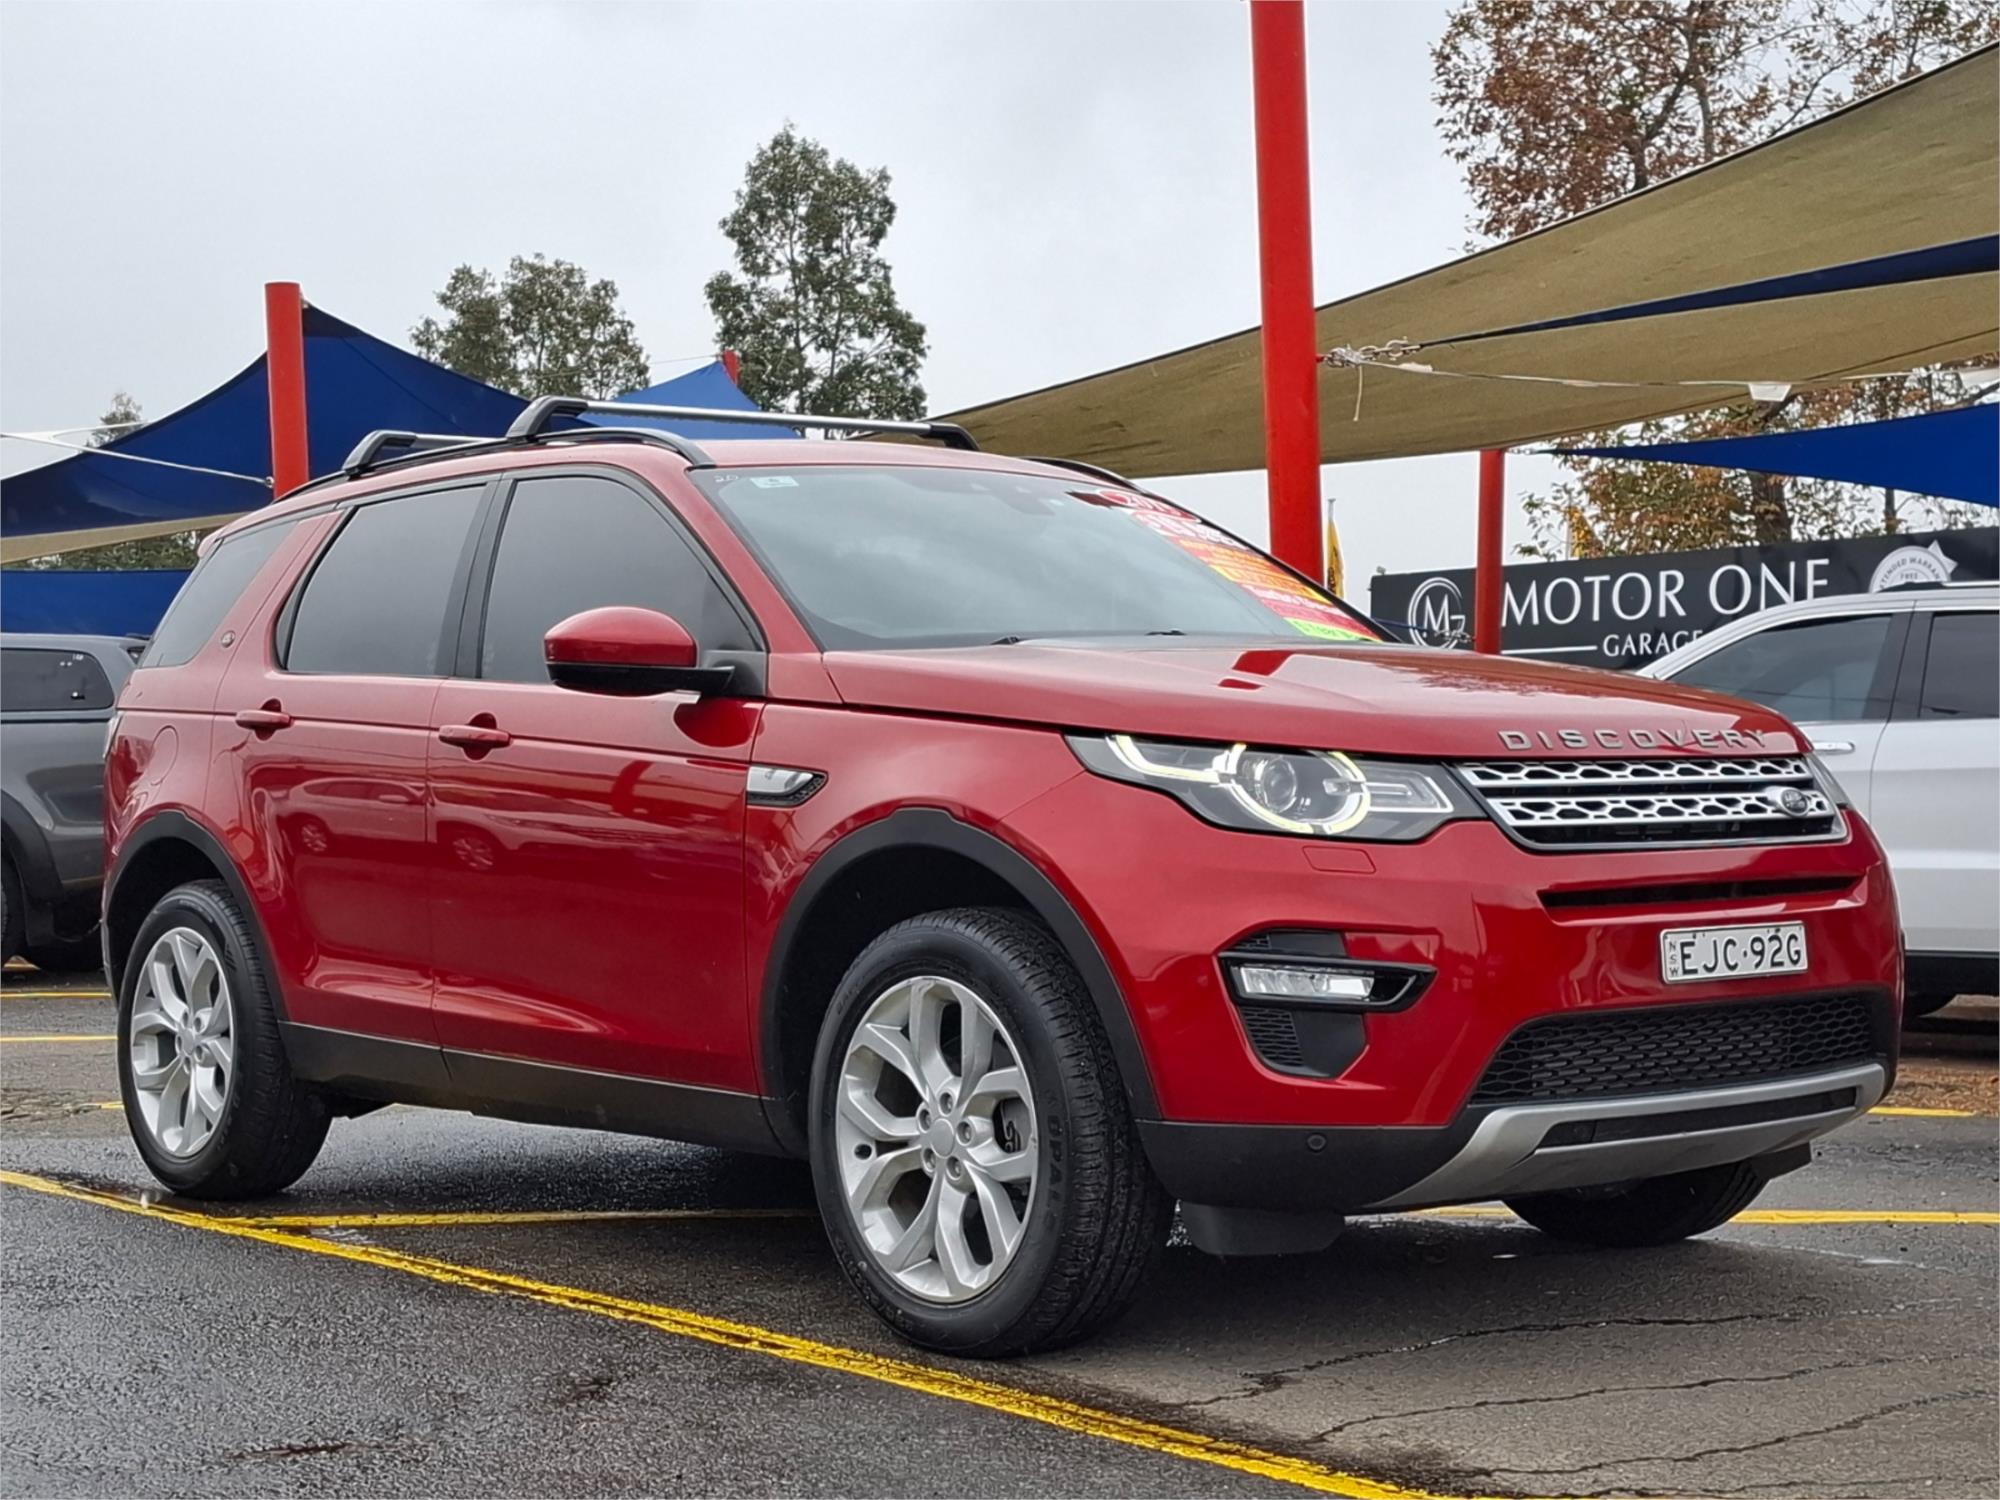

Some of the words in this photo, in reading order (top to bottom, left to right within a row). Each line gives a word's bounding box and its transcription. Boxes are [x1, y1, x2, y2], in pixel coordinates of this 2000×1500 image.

[1501, 570, 1687, 628] MOTOR
[1709, 558, 1830, 615] ONE
[1498, 729, 1766, 750] DISCOVERY
